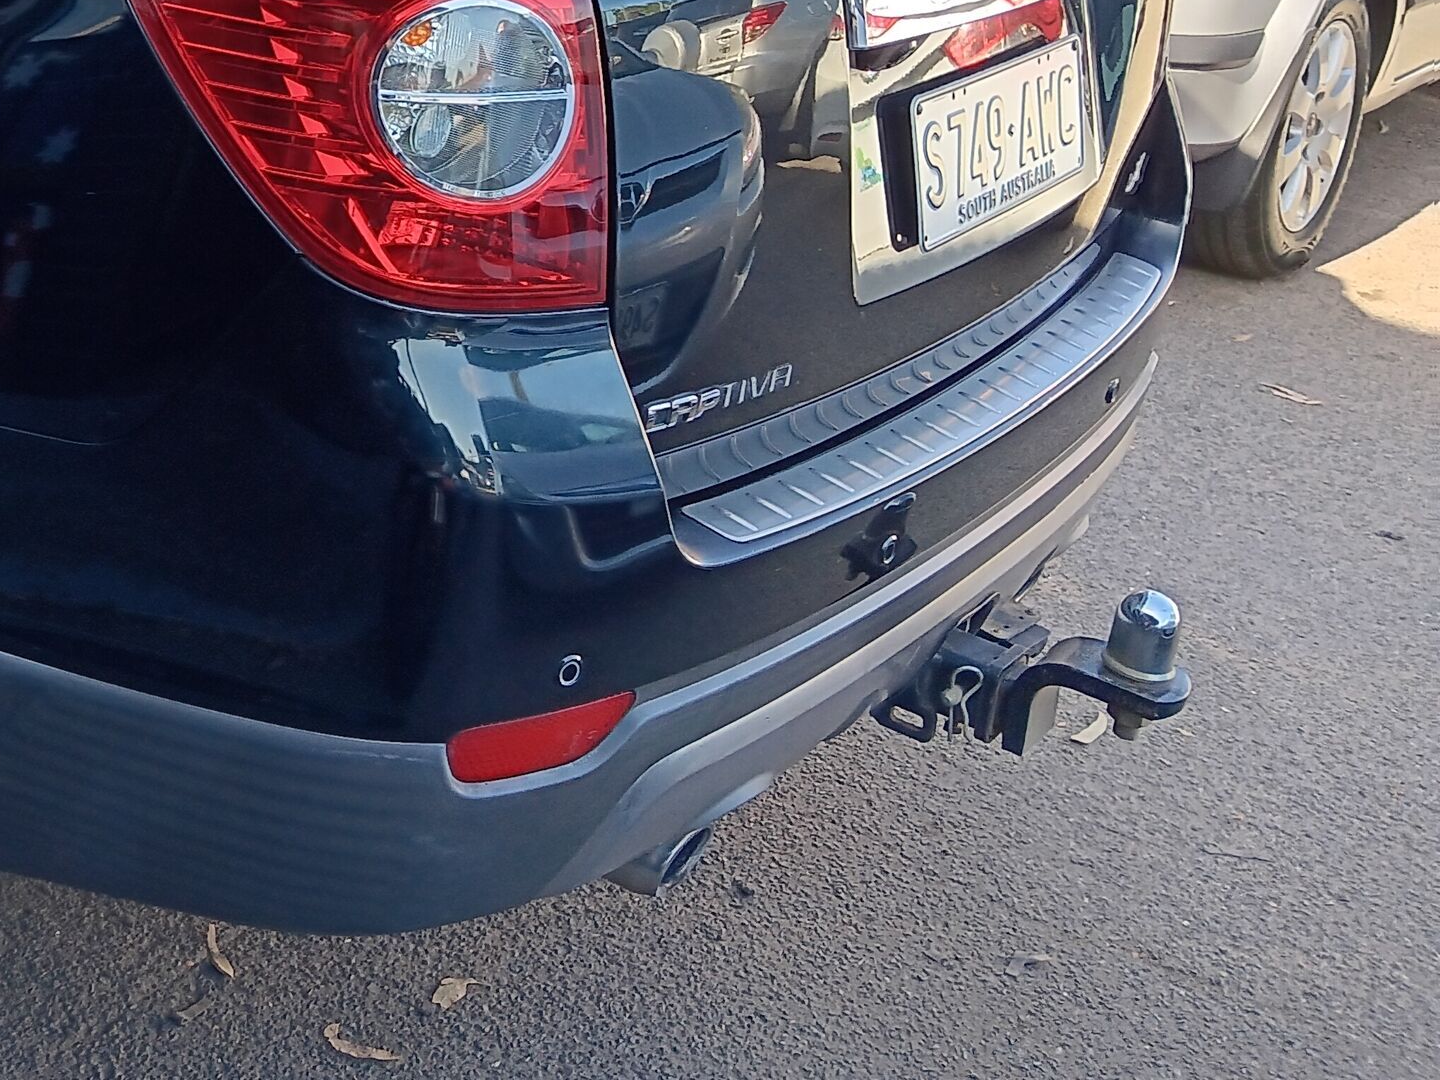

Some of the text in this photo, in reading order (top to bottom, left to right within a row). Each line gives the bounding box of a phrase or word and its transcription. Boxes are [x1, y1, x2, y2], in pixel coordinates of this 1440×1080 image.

[958, 159, 1056, 224] SOUTH AUSTRALIA
[644, 362, 793, 433] CAPTIVA
